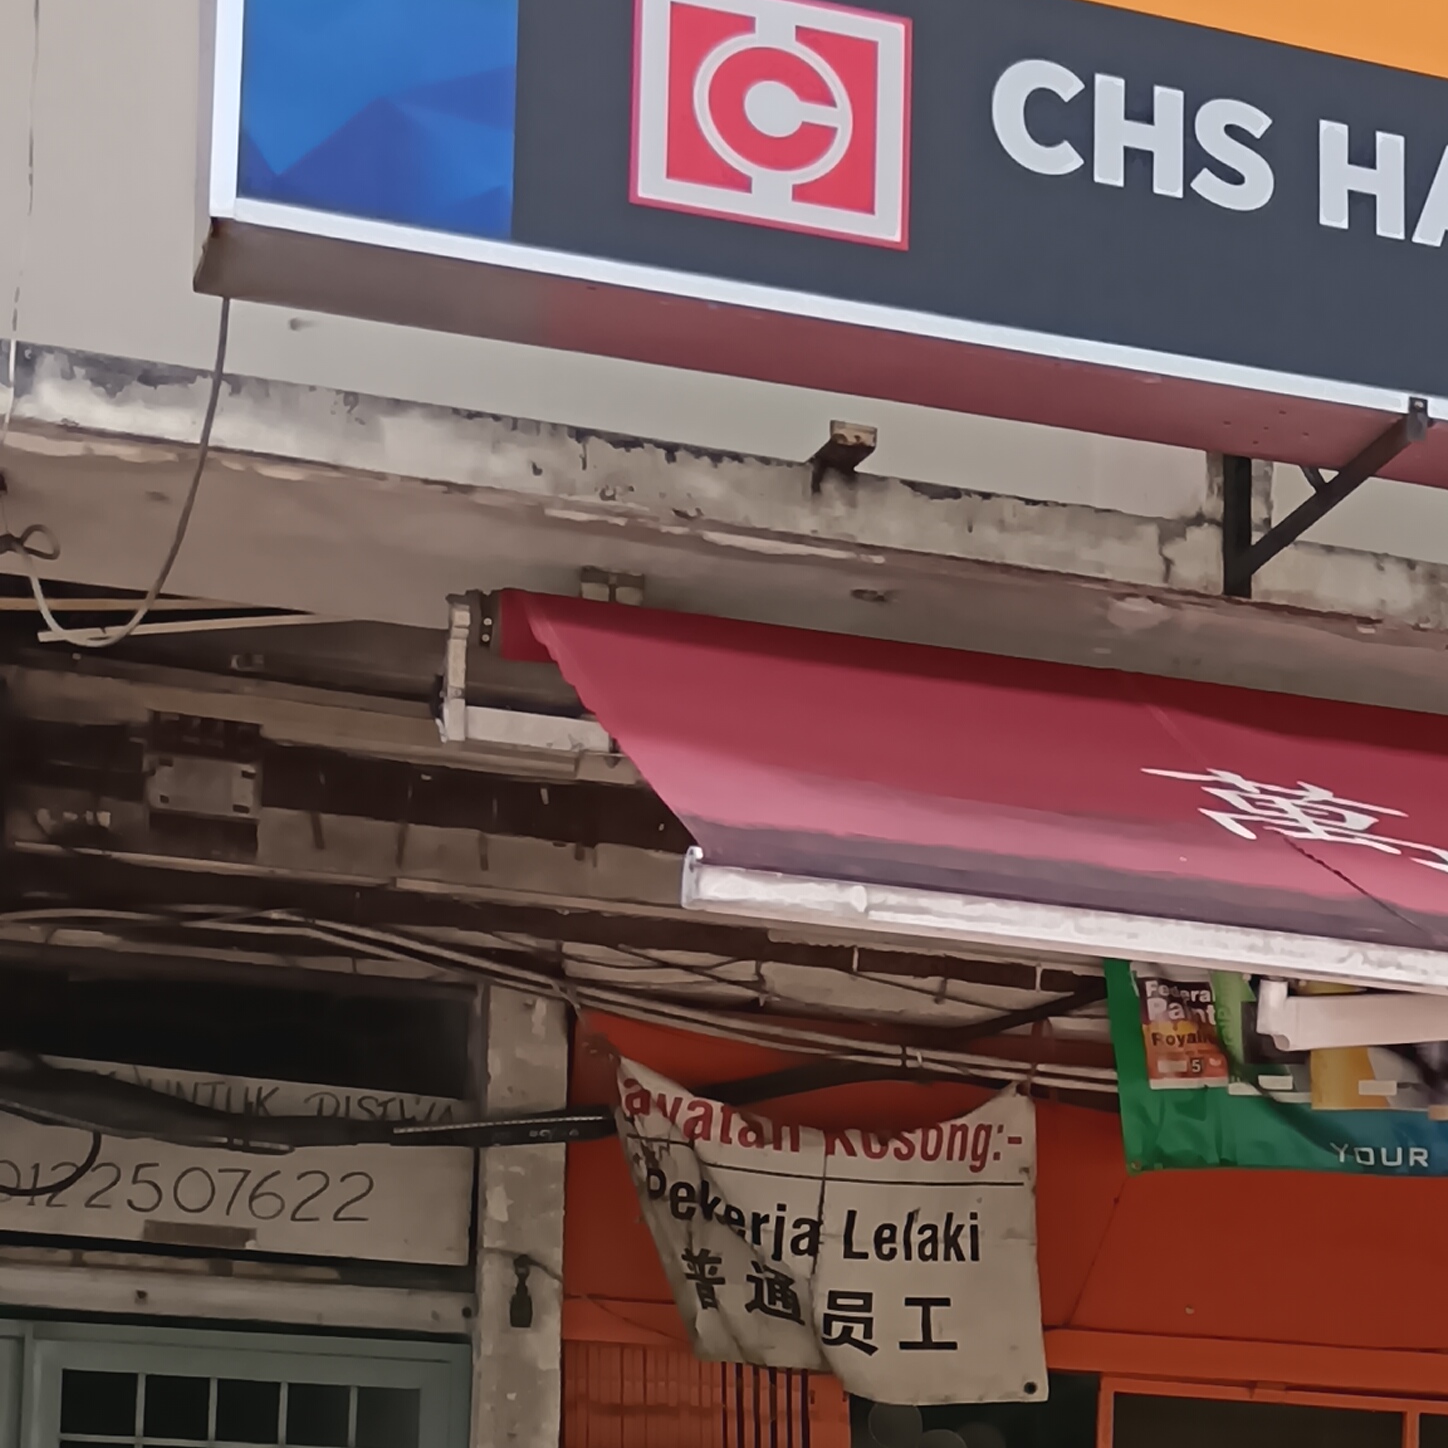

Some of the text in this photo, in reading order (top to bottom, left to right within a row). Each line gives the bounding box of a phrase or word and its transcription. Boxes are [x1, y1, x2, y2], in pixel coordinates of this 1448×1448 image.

[991, 58, 1275, 212] CHS
[1329, 1141, 1430, 1169] YOUR
[842, 1208, 981, 1263] Lelaki
[681, 1247, 959, 1356] 普通员工
